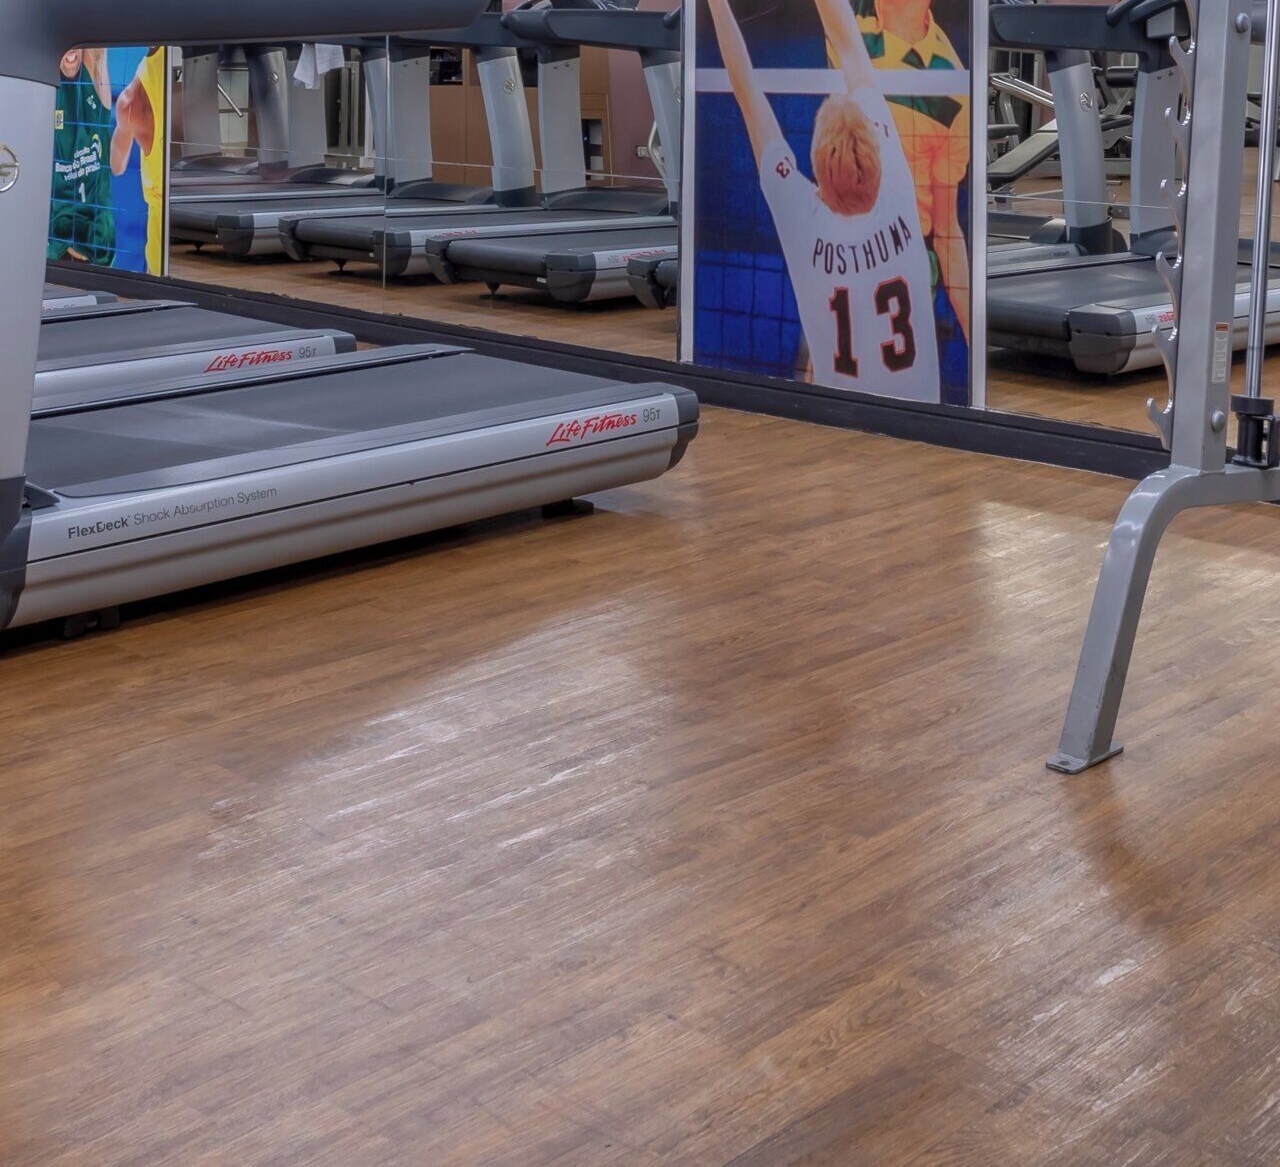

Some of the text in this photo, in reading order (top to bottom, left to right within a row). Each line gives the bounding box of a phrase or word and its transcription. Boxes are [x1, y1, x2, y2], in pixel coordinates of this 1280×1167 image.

[78, 182, 87, 203] 1
[812, 215, 912, 275] POSTHUMA
[828, 275, 916, 379] 13
[133, 508, 171, 526] Shock
[173, 494, 236, 518] Absorption
[236, 486, 278, 505] System
